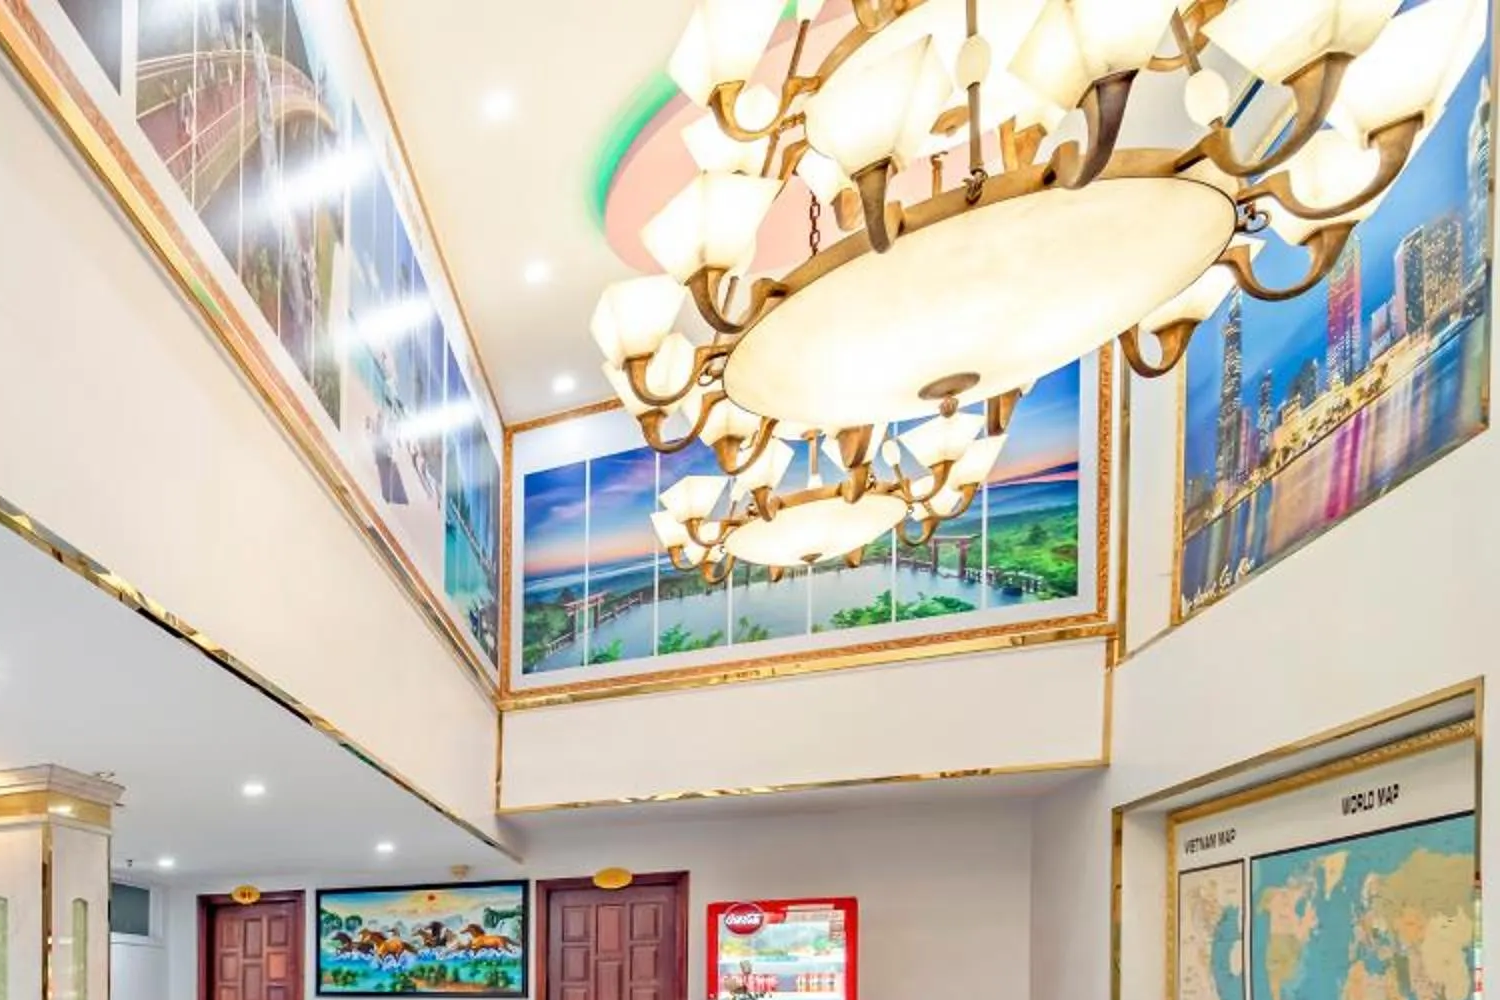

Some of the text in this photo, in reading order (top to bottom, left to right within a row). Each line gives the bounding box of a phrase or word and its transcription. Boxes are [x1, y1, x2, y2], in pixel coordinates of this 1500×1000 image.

[1341, 783, 1399, 815] WORLD MAP
[1184, 827, 1236, 854] VIETNAM MAP
